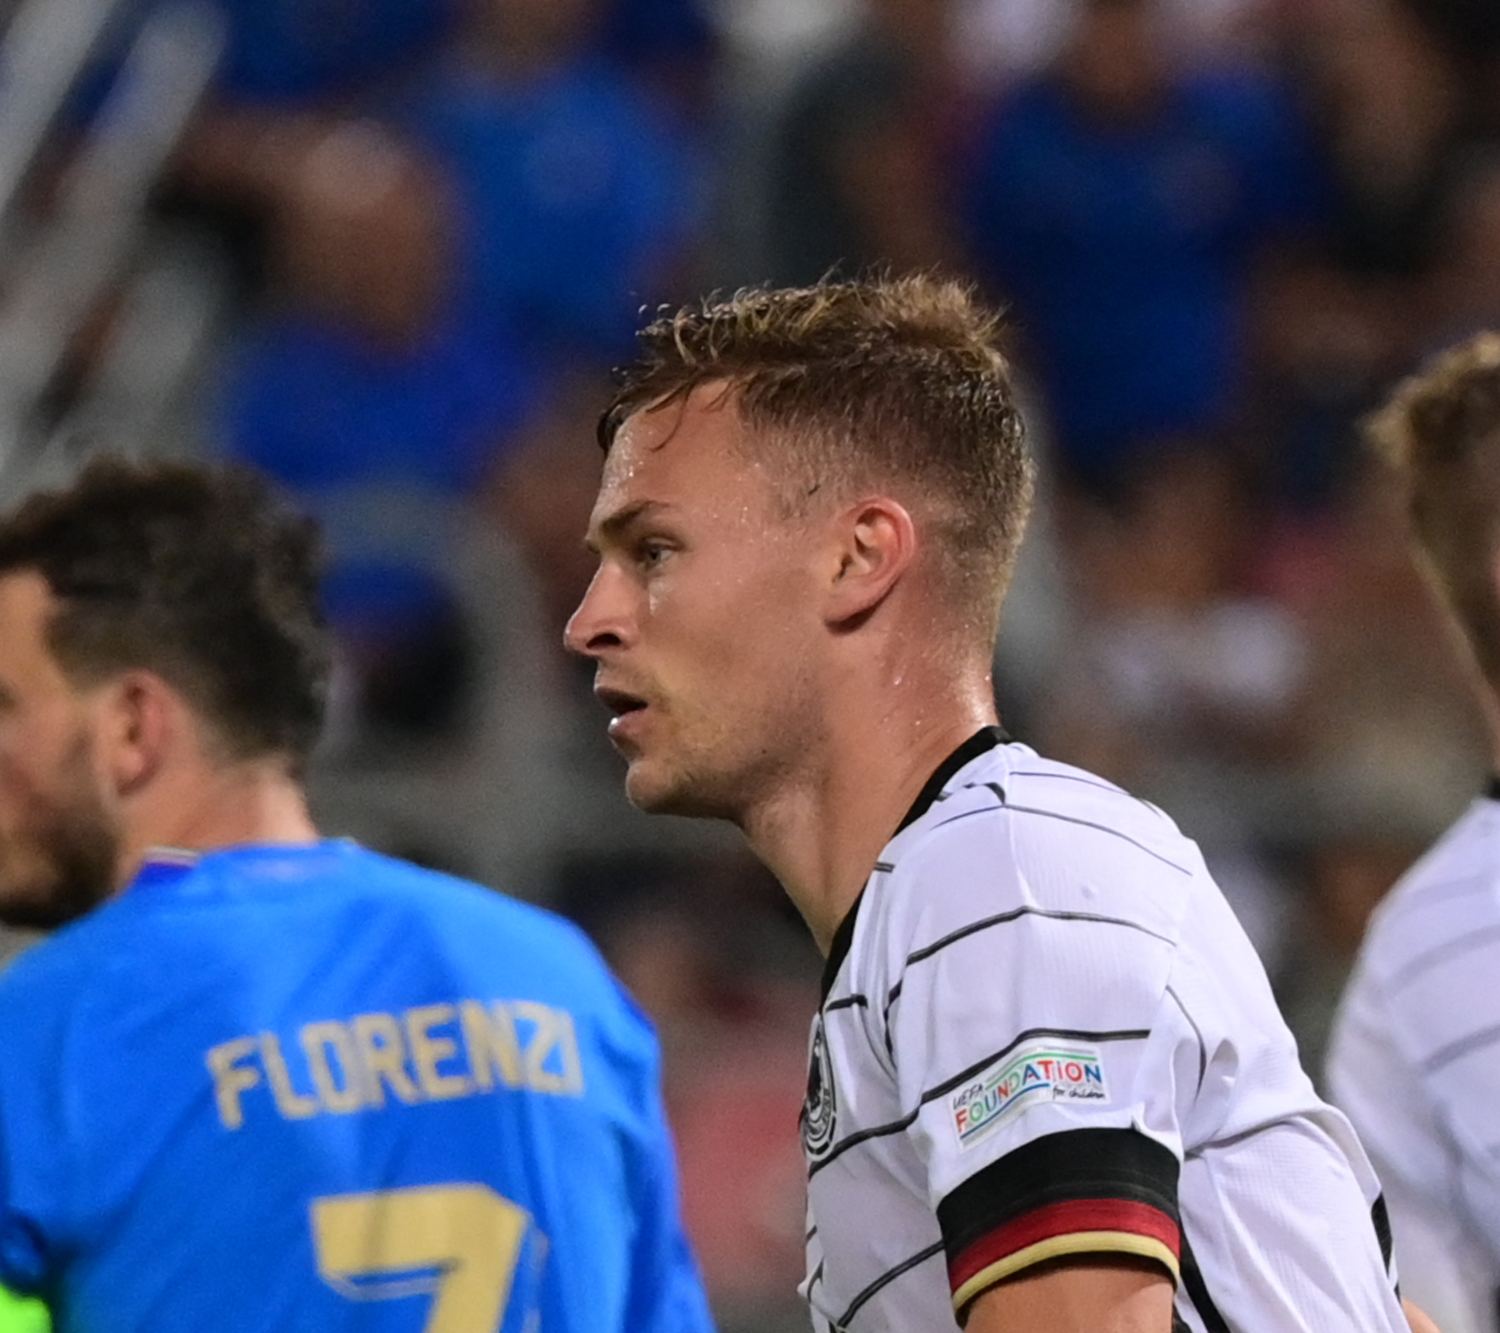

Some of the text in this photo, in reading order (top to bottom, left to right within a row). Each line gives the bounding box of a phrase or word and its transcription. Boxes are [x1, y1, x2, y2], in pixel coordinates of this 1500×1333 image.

[205, 998, 584, 1132] FLORENZI
[953, 1083, 984, 1110] UEFA
[955, 1060, 1103, 1132] FOUNDATION
